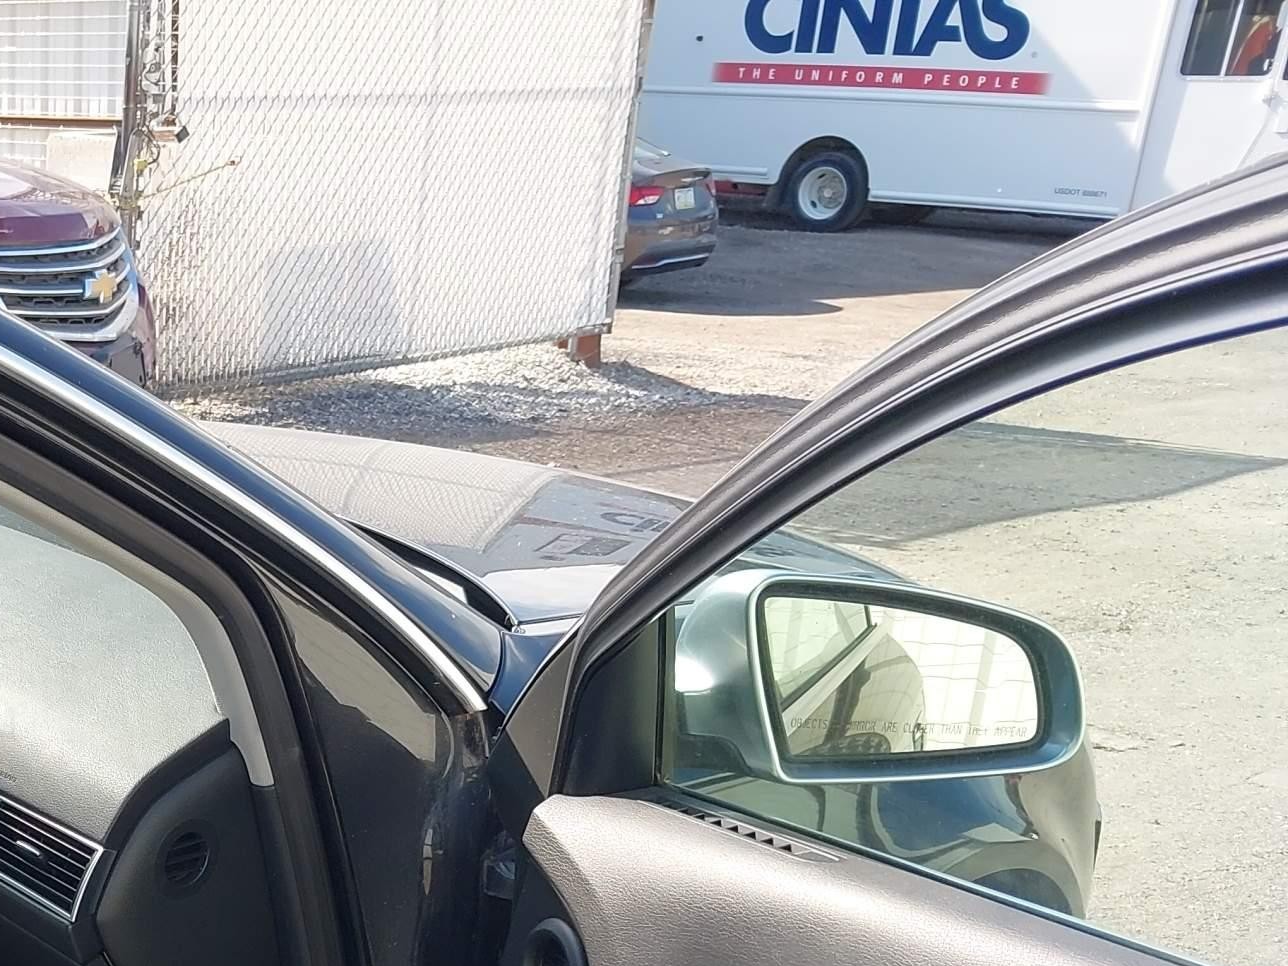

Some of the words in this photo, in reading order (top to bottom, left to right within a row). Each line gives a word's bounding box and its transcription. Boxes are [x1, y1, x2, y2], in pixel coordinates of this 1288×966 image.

[738, 67, 777, 80] THE
[795, 68, 904, 84] UNIFORM
[924, 73, 1021, 89] PEOPLE
